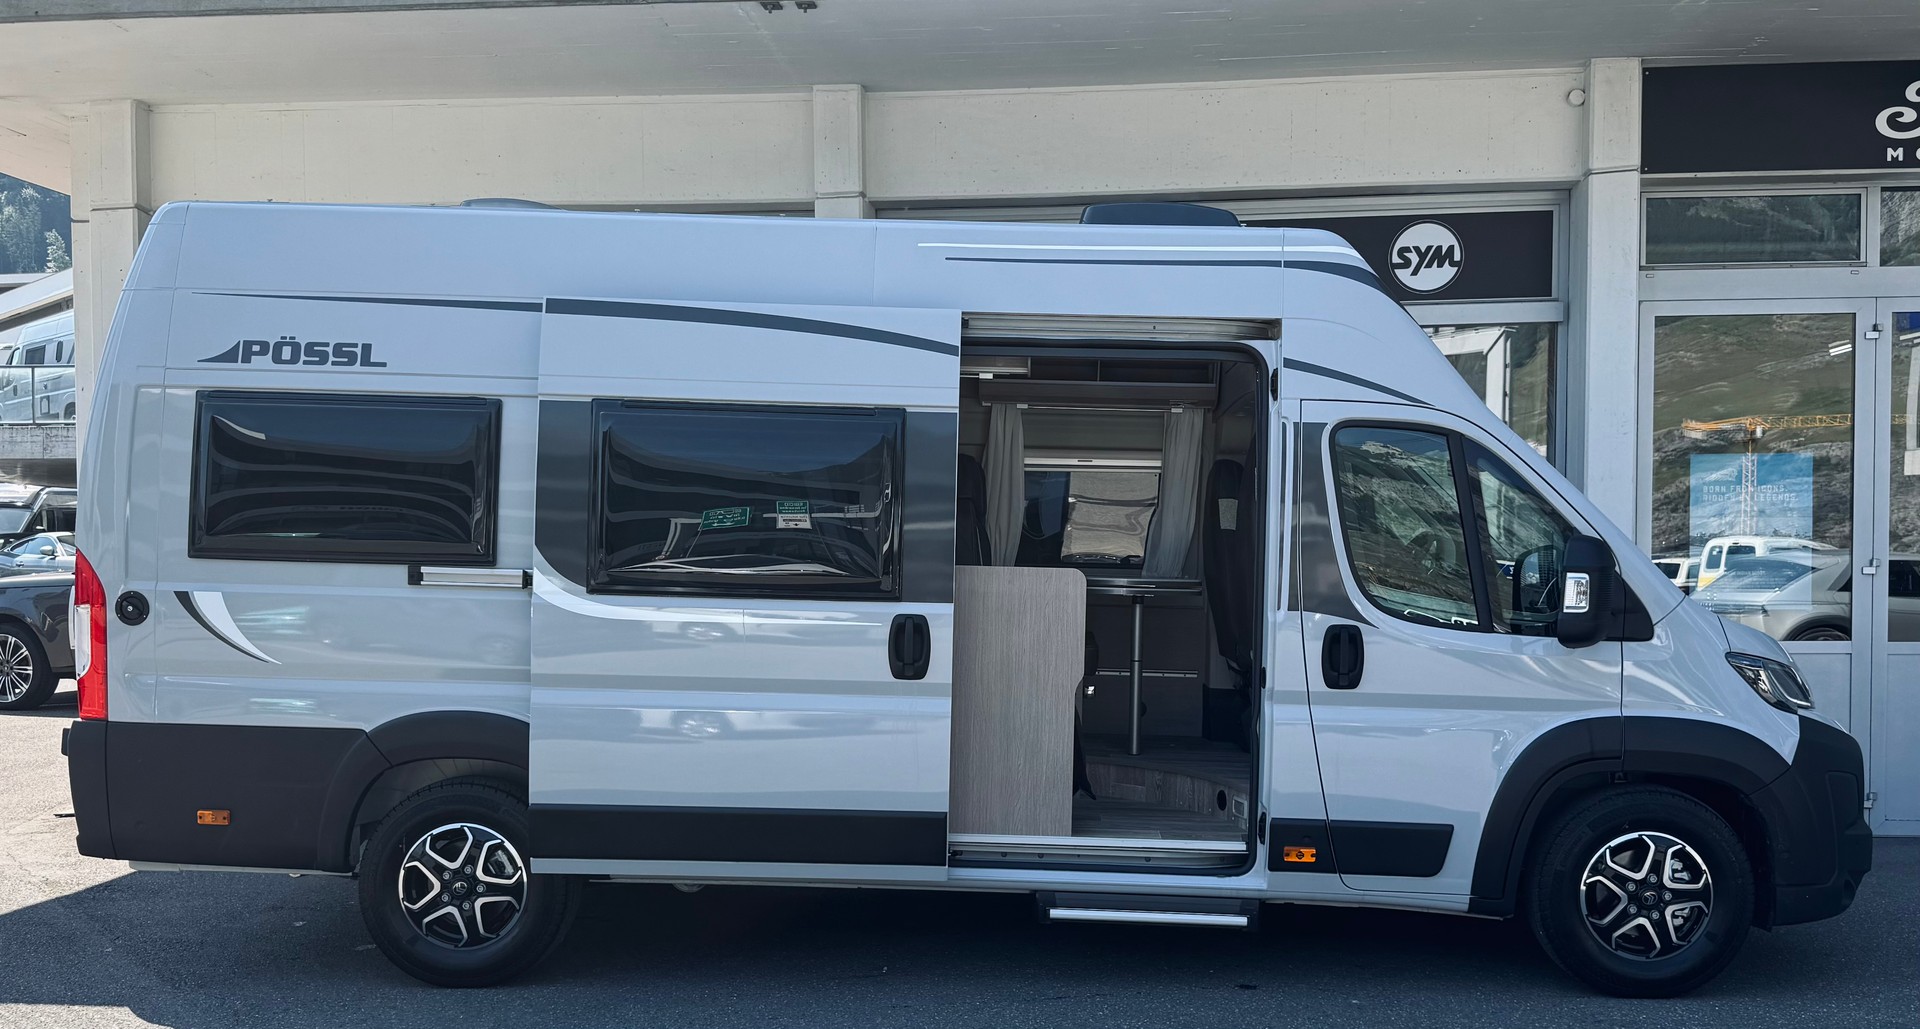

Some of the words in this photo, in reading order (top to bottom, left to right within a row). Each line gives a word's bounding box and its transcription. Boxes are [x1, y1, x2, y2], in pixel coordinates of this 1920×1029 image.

[1392, 244, 1461, 277] SYM
[240, 335, 388, 368] PÖSSL
[1702, 485, 1726, 493] BORN
[1757, 484, 1788, 493] ICONS.
